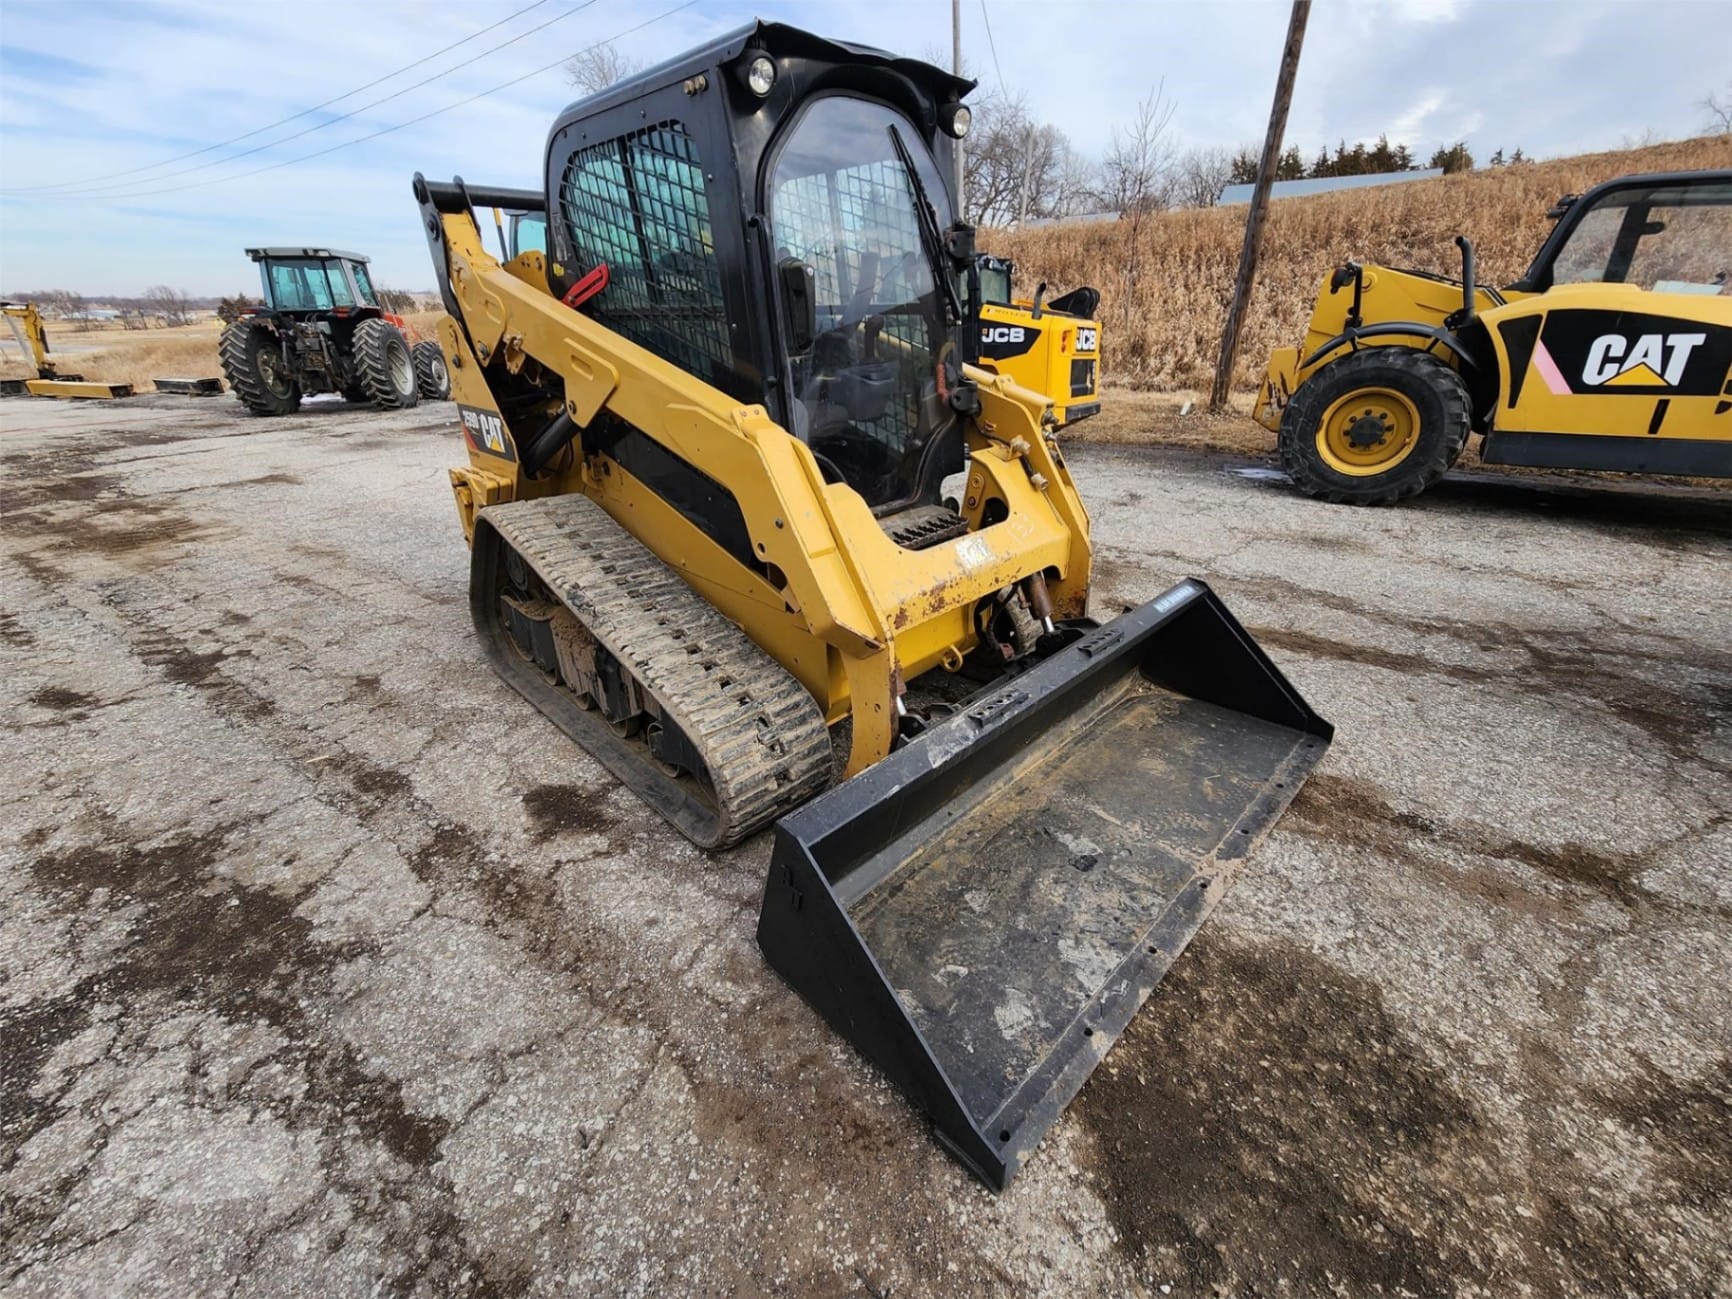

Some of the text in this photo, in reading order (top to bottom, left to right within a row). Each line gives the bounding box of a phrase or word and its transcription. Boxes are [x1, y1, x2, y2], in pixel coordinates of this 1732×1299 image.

[981, 327, 1025, 343] JCB
[1075, 328, 1097, 351] JCB
[1582, 333, 1707, 386] CAT
[480, 413, 506, 454] CAT
